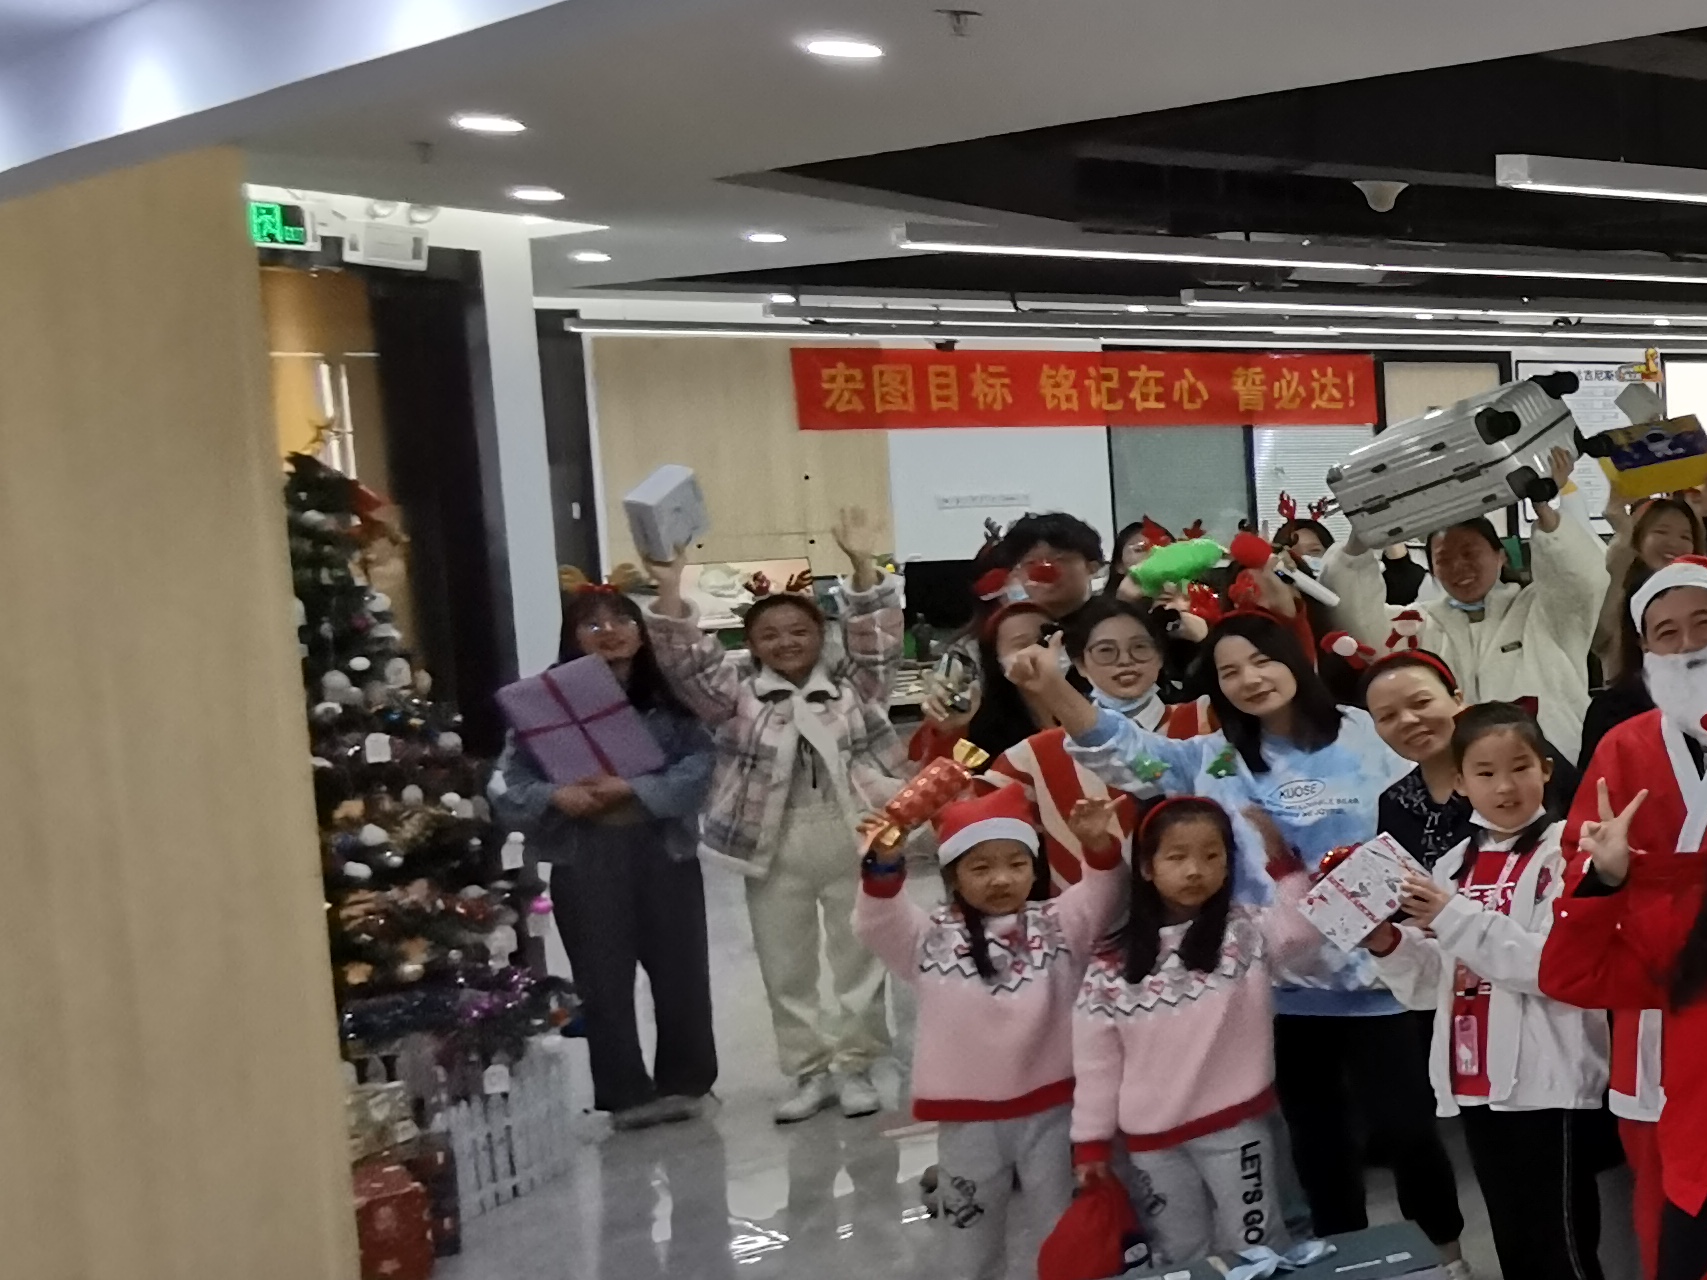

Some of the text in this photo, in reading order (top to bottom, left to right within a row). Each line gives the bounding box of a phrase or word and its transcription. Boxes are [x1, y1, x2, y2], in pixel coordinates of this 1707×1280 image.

[821, 362, 1012, 412] 宏图目标
[1038, 364, 1210, 410] 铭记在心
[1240, 1140, 1265, 1245] LET'S GO
